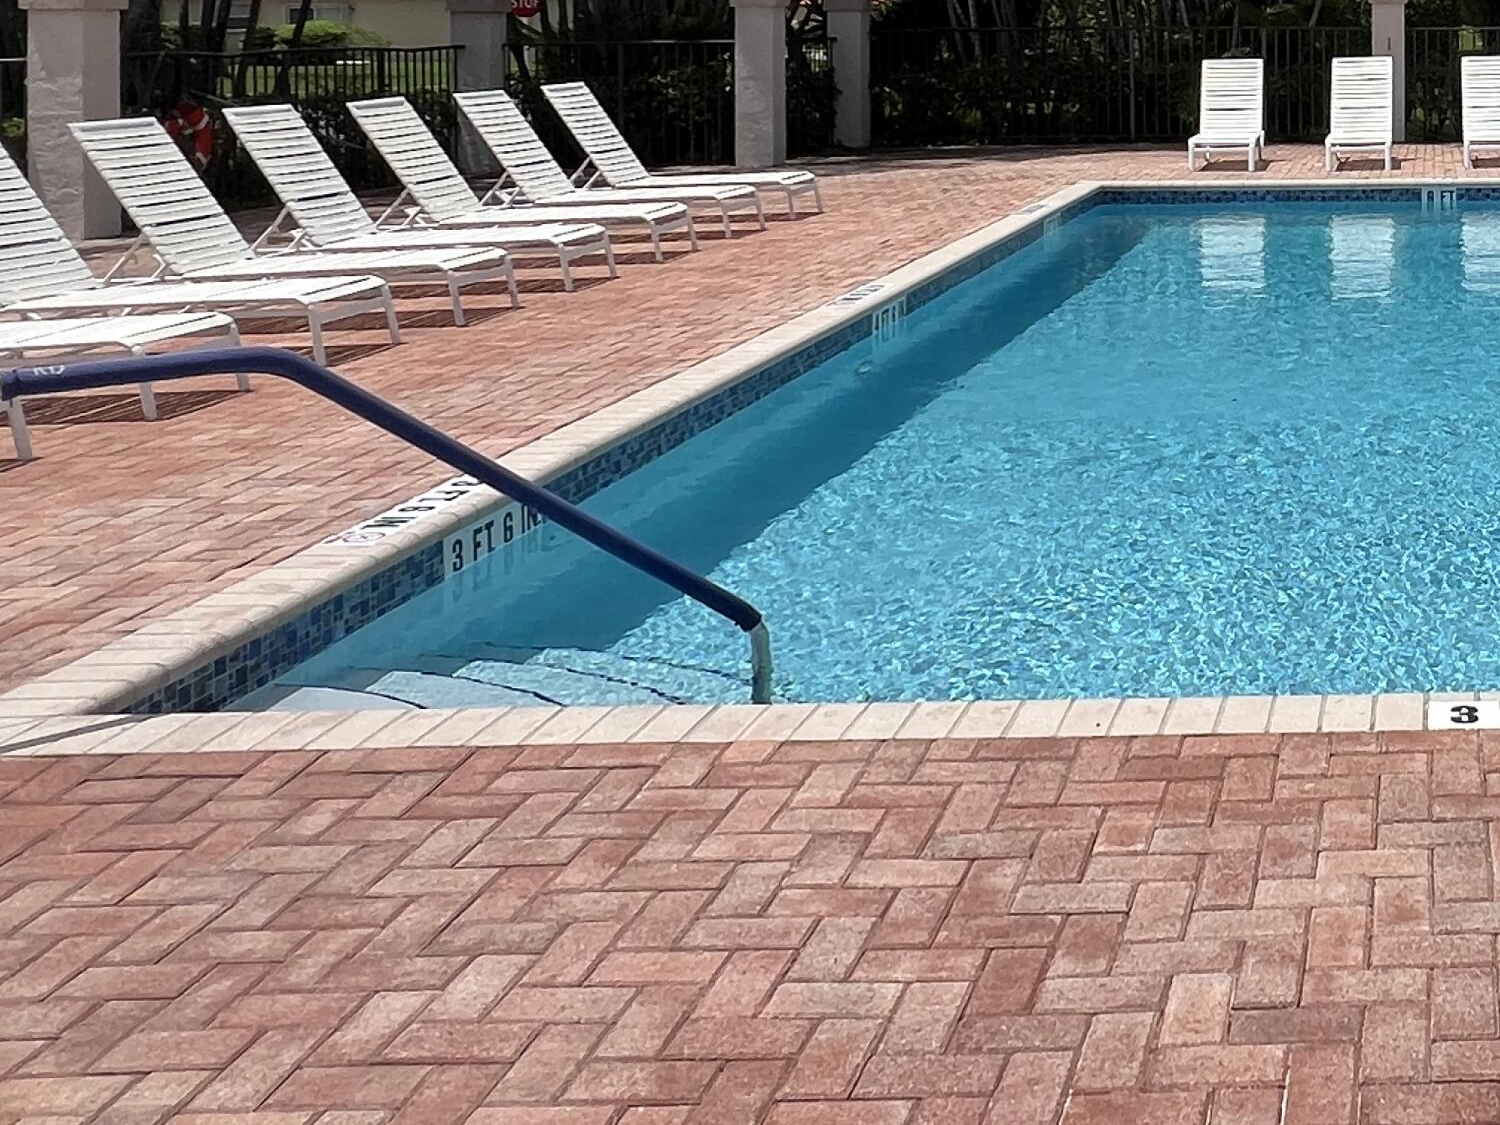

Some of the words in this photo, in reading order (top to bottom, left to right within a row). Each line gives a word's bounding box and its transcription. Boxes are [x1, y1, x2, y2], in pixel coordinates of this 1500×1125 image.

[452, 539, 464, 572] 3
[503, 511, 514, 543] 6
[1450, 705, 1479, 724] 3
